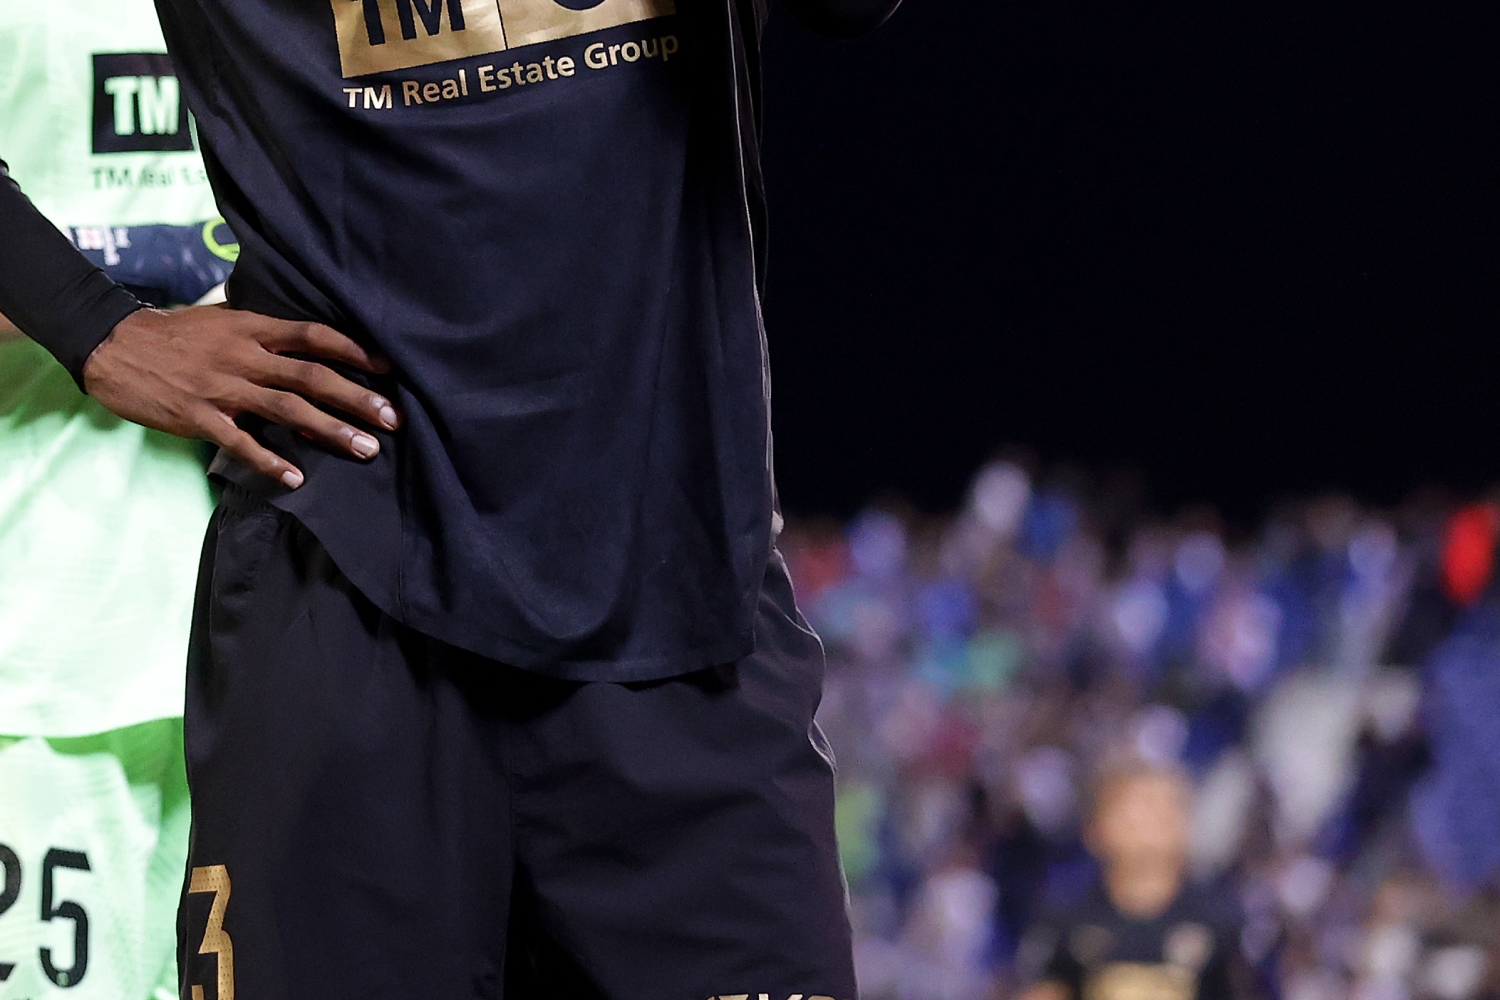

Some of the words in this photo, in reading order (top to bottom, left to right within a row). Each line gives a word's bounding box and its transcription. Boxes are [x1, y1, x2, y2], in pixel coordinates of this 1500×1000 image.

[103, 75, 181, 136] TM
[342, 84, 393, 110] TM
[403, 69, 469, 106] Real
[477, 55, 576, 93] Estate
[583, 33, 680, 70] Group
